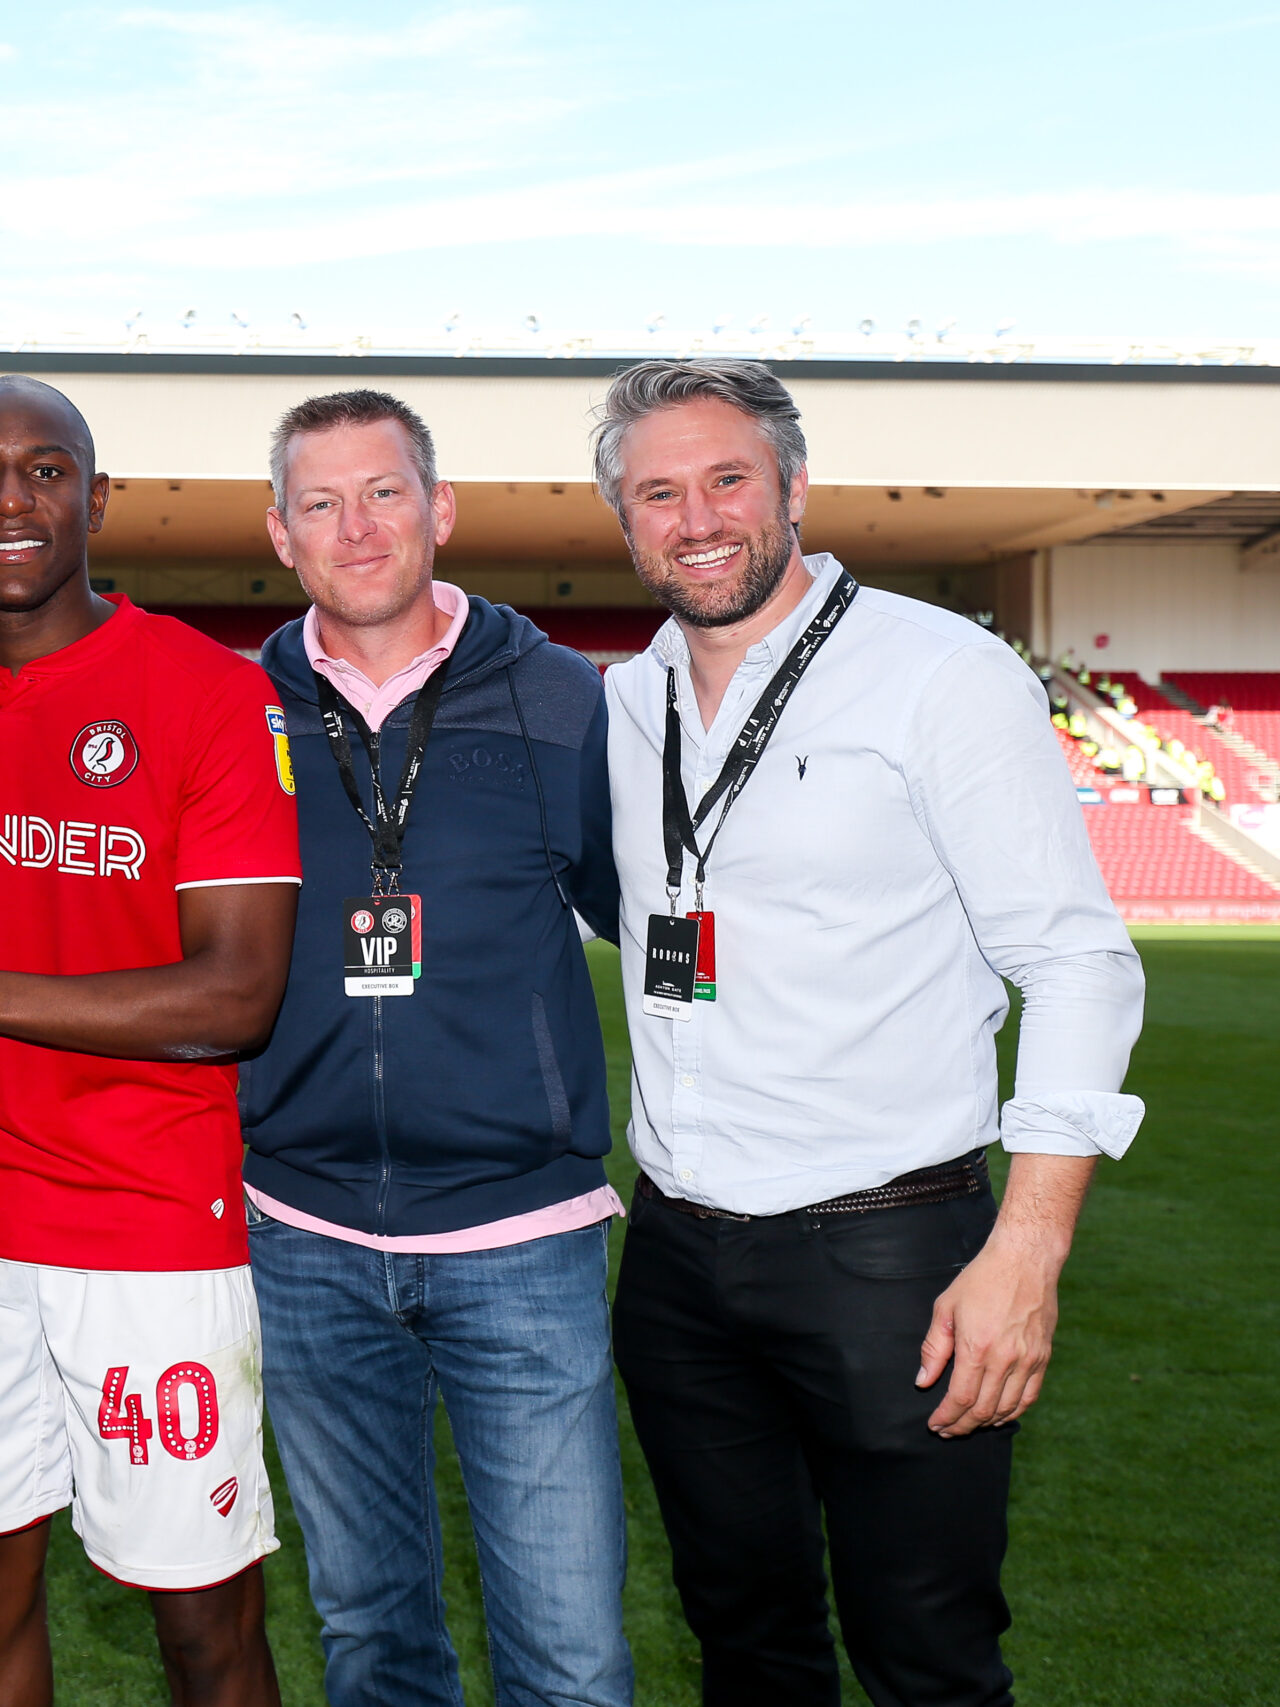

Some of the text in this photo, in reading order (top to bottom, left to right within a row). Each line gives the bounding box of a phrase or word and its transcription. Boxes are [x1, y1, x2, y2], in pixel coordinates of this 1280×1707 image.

[89, 724, 126, 739] BRISTOL
[323, 712, 338, 737] VIP
[738, 718, 759, 746] VIP
[754, 717, 774, 754] ASHTON GATE
[84, 772, 110, 782] CITY
[360, 936, 397, 965] VIP
[98, 1361, 219, 1465] 40
